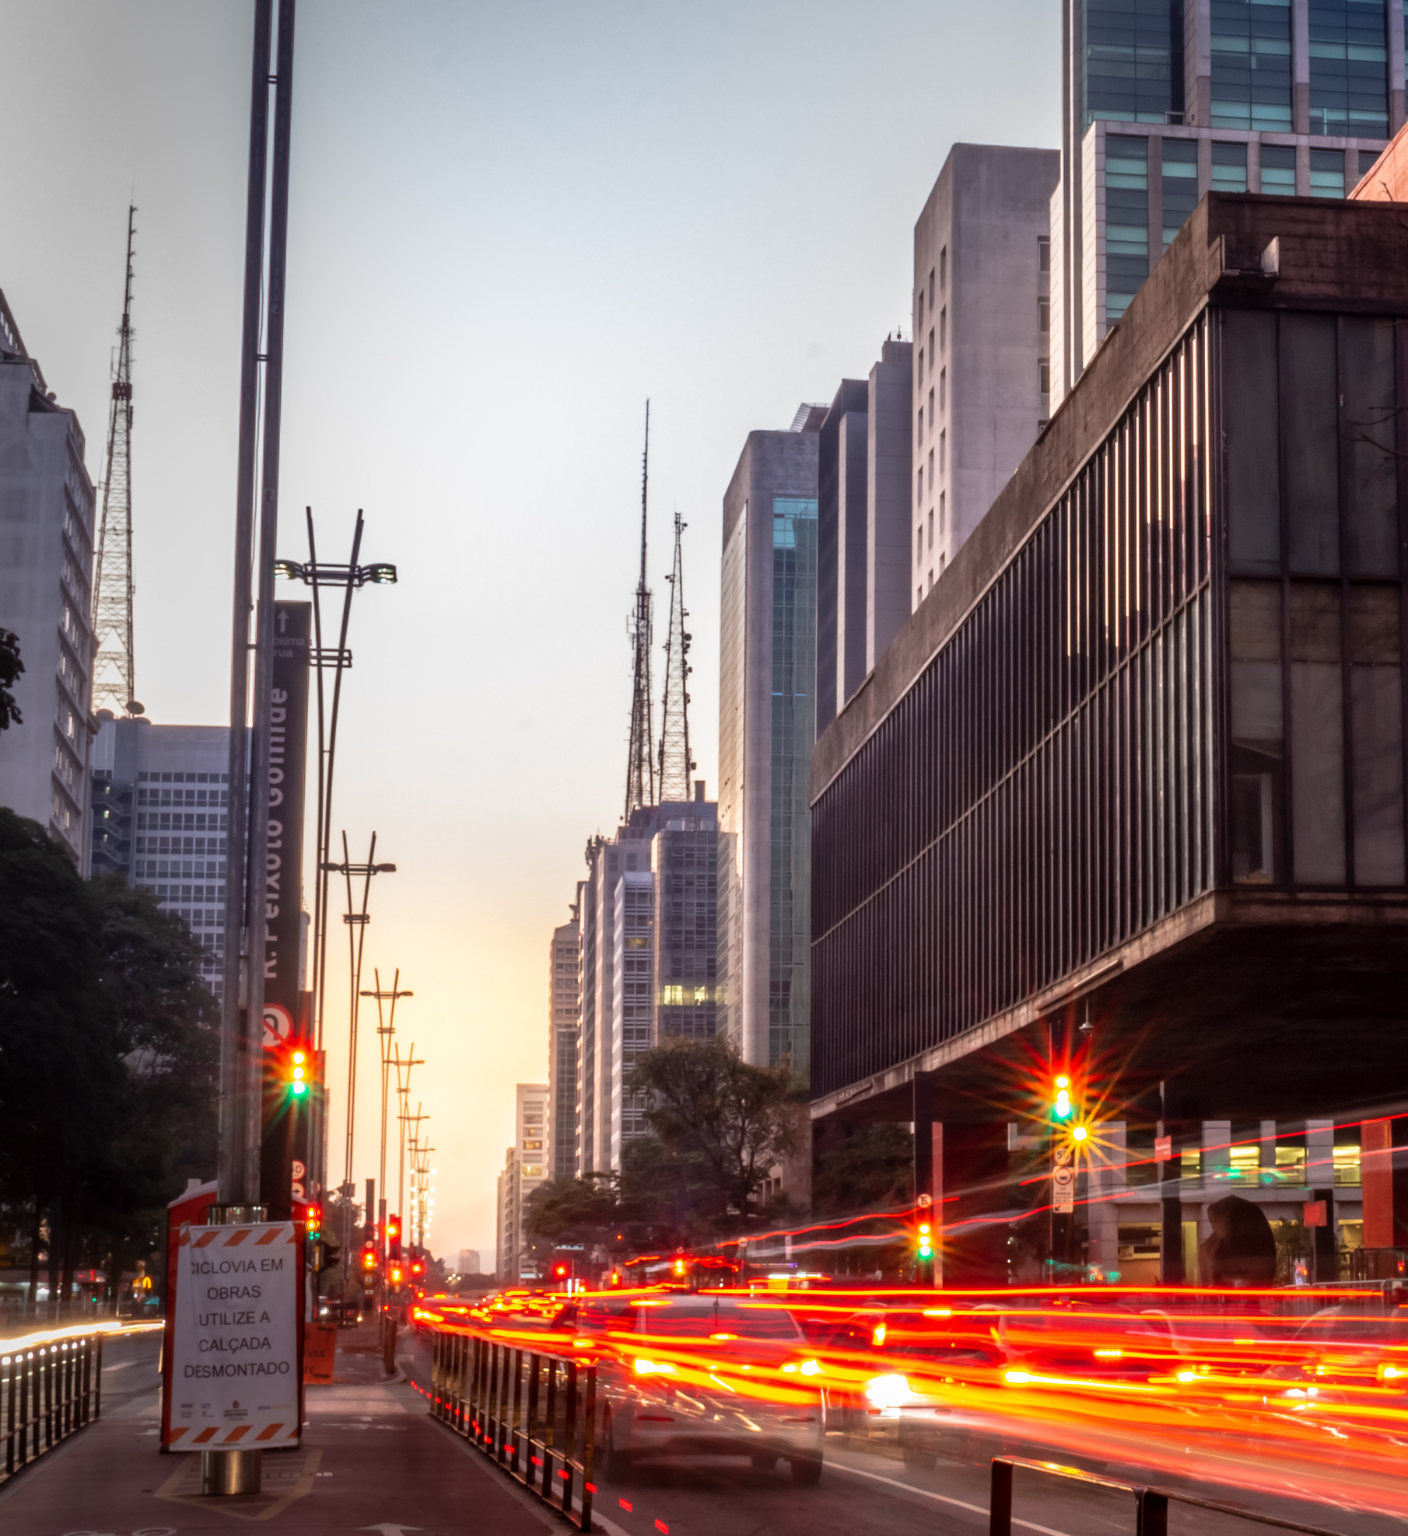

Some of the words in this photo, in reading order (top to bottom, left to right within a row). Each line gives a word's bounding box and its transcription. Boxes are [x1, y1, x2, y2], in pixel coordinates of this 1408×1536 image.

[274, 649, 293, 658] rua
[260, 1258, 284, 1272] EM
[207, 1285, 261, 1300] OBRAS
[198, 1311, 256, 1327] UTILIZE
[260, 1310, 271, 1324] A
[198, 1336, 272, 1354] CALÇADA
[184, 1361, 290, 1379] DESMONTADO
